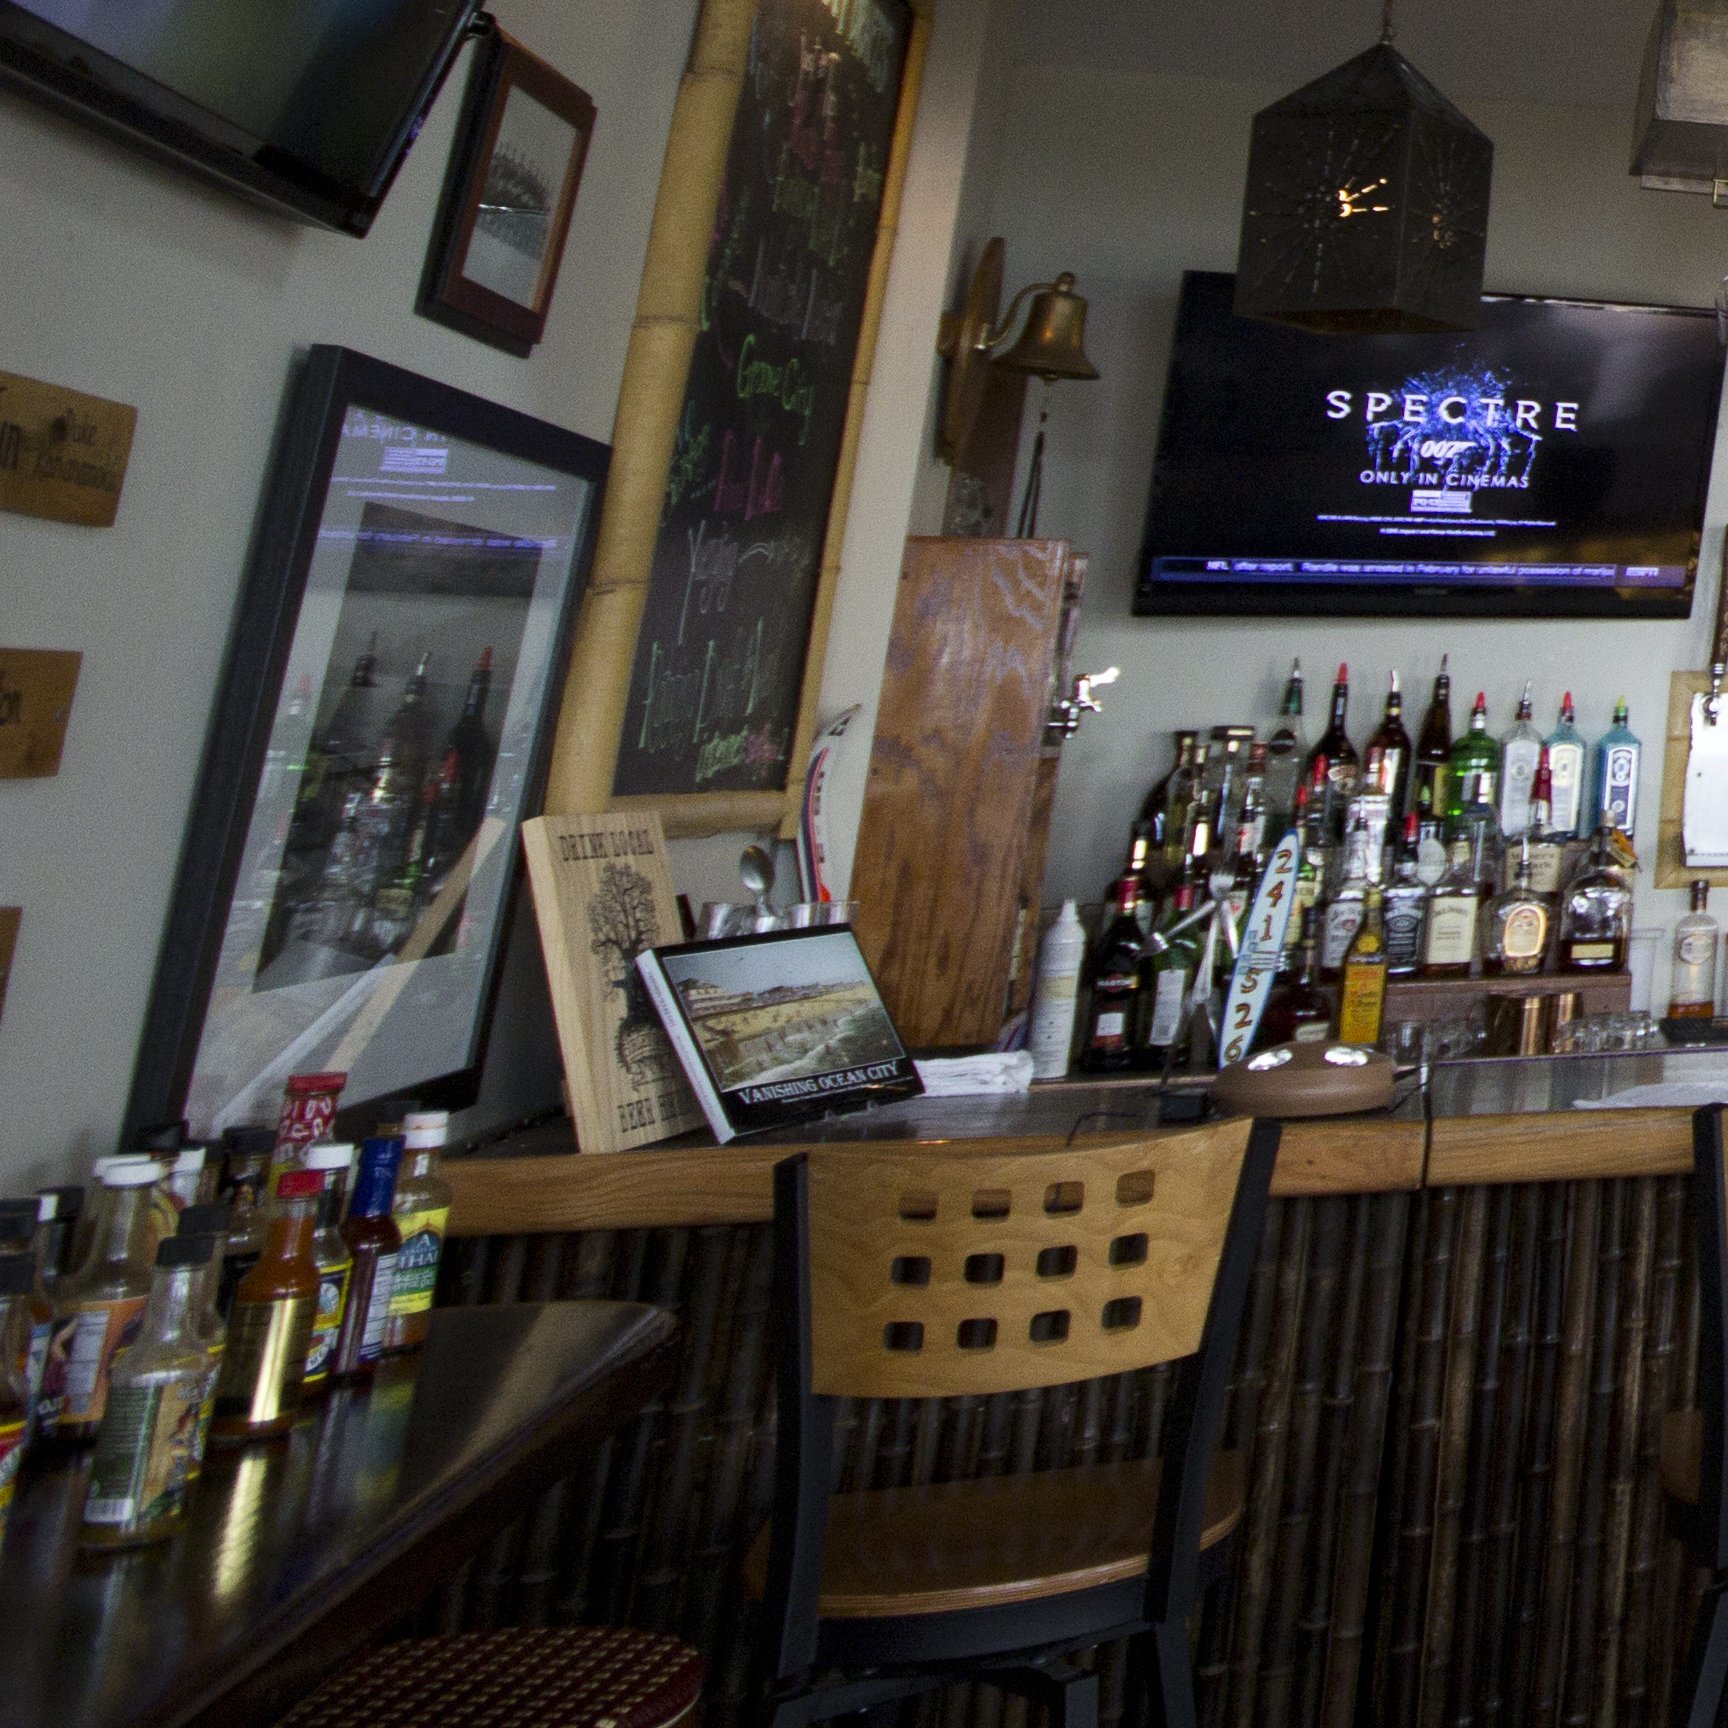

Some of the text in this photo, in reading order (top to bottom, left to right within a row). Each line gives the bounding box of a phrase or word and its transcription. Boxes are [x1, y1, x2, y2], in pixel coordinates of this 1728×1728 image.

[1326, 390, 1579, 432] SPECTRE
[1420, 441, 1472, 459] 007
[1360, 470, 1529, 489] ONLY IN CINEMAS
[1207, 560, 1228, 570] NFL
[559, 828, 655, 862] DRINK LOCAL
[738, 1060, 899, 1104] VANISHING OCEAN CITY
